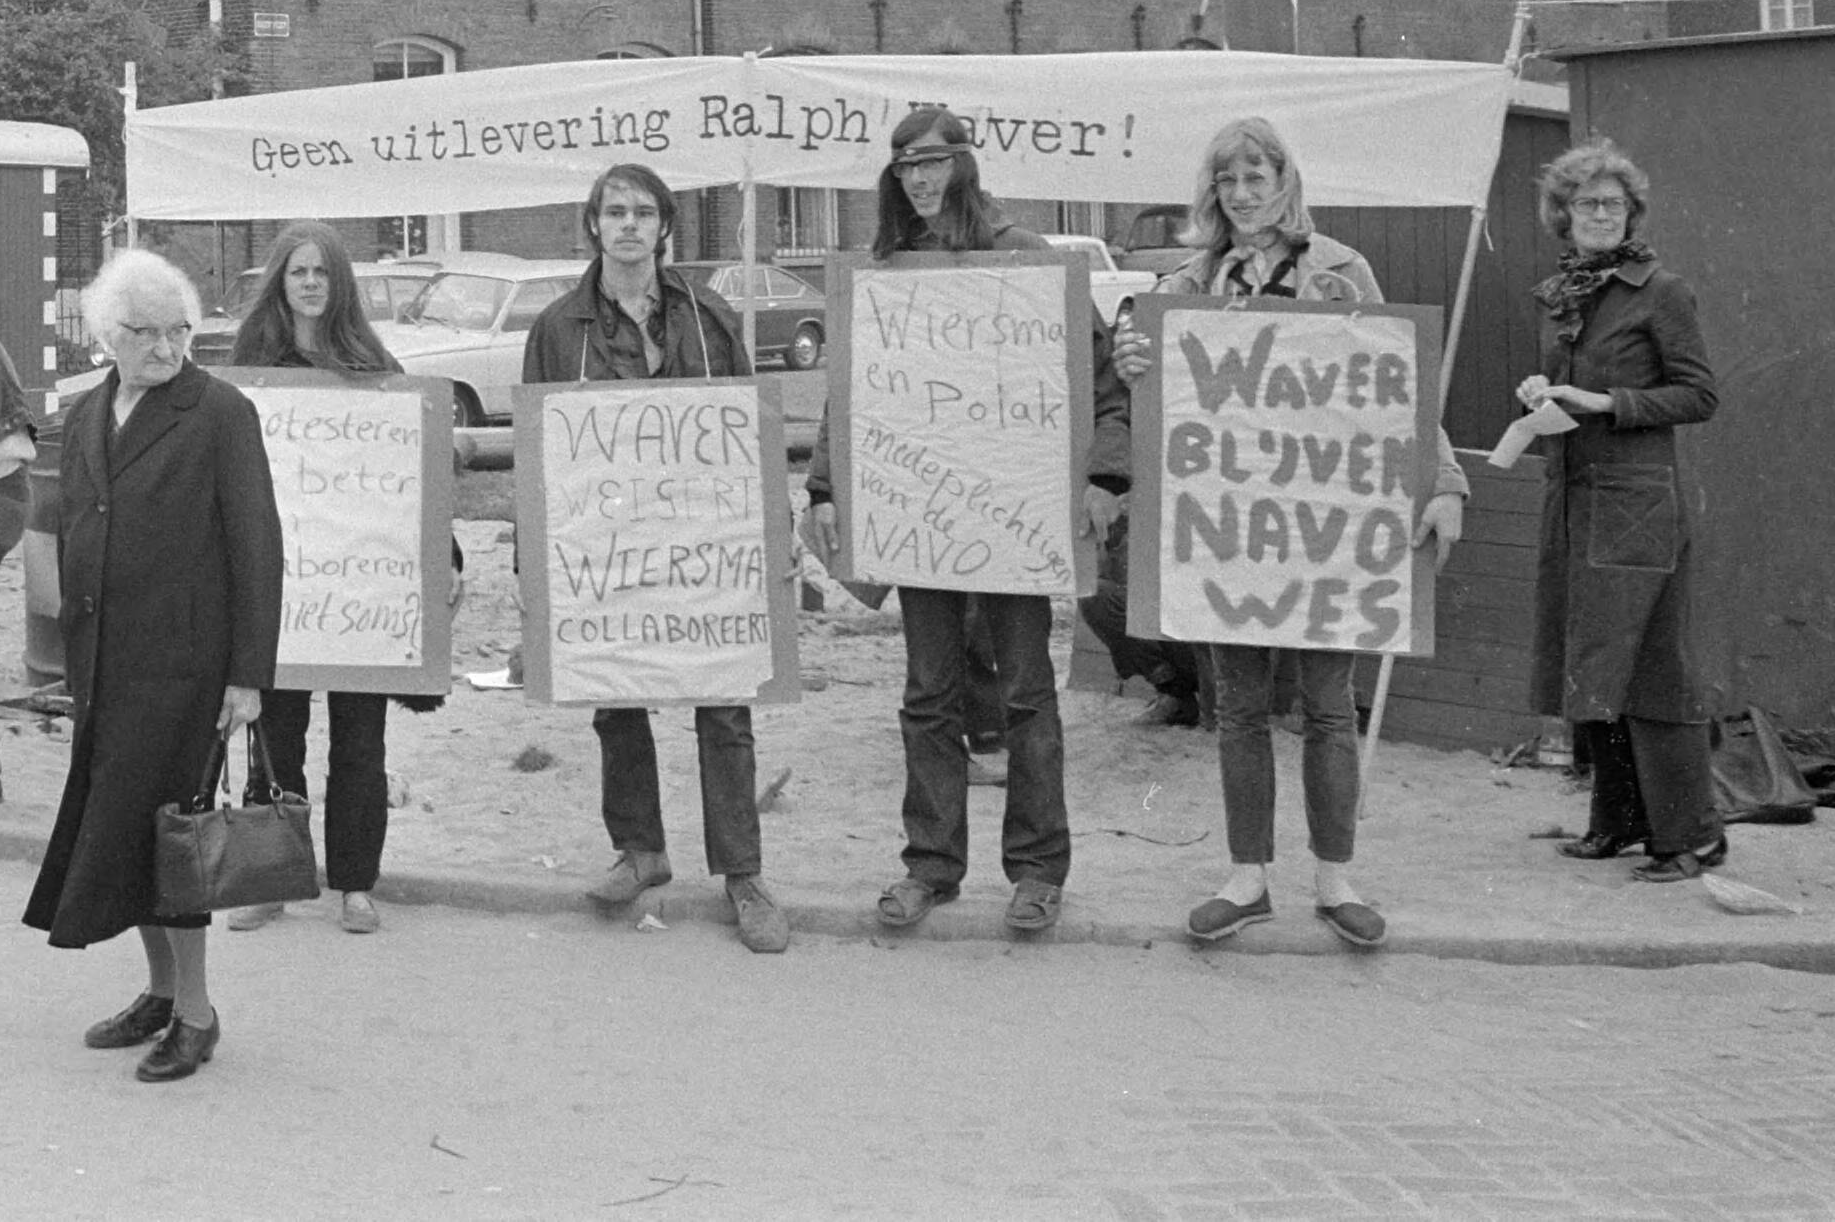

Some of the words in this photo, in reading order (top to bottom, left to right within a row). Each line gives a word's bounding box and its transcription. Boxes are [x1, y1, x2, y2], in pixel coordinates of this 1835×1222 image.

[252, 135, 354, 172] Geen
[370, 106, 671, 162] uitlevering
[699, 94, 871, 151] Ralph
[907, 100, 1136, 159] aver!
[866, 281, 1065, 351] Wiersma
[866, 361, 910, 394] en
[922, 380, 1064, 430] Polak
[1178, 322, 1410, 415] WAVER
[265, 406, 419, 446] otesteren
[551, 402, 756, 466] WAVER
[300, 455, 418, 495] beter
[860, 469, 913, 511] van
[922, 506, 956, 541] de
[554, 531, 764, 603] WIERSMA
[863, 511, 992, 576] NAVO
[1173, 490, 1408, 577] NAVO
[556, 612, 770, 649] COLLABOREERT
[1203, 577, 1402, 650] WES
